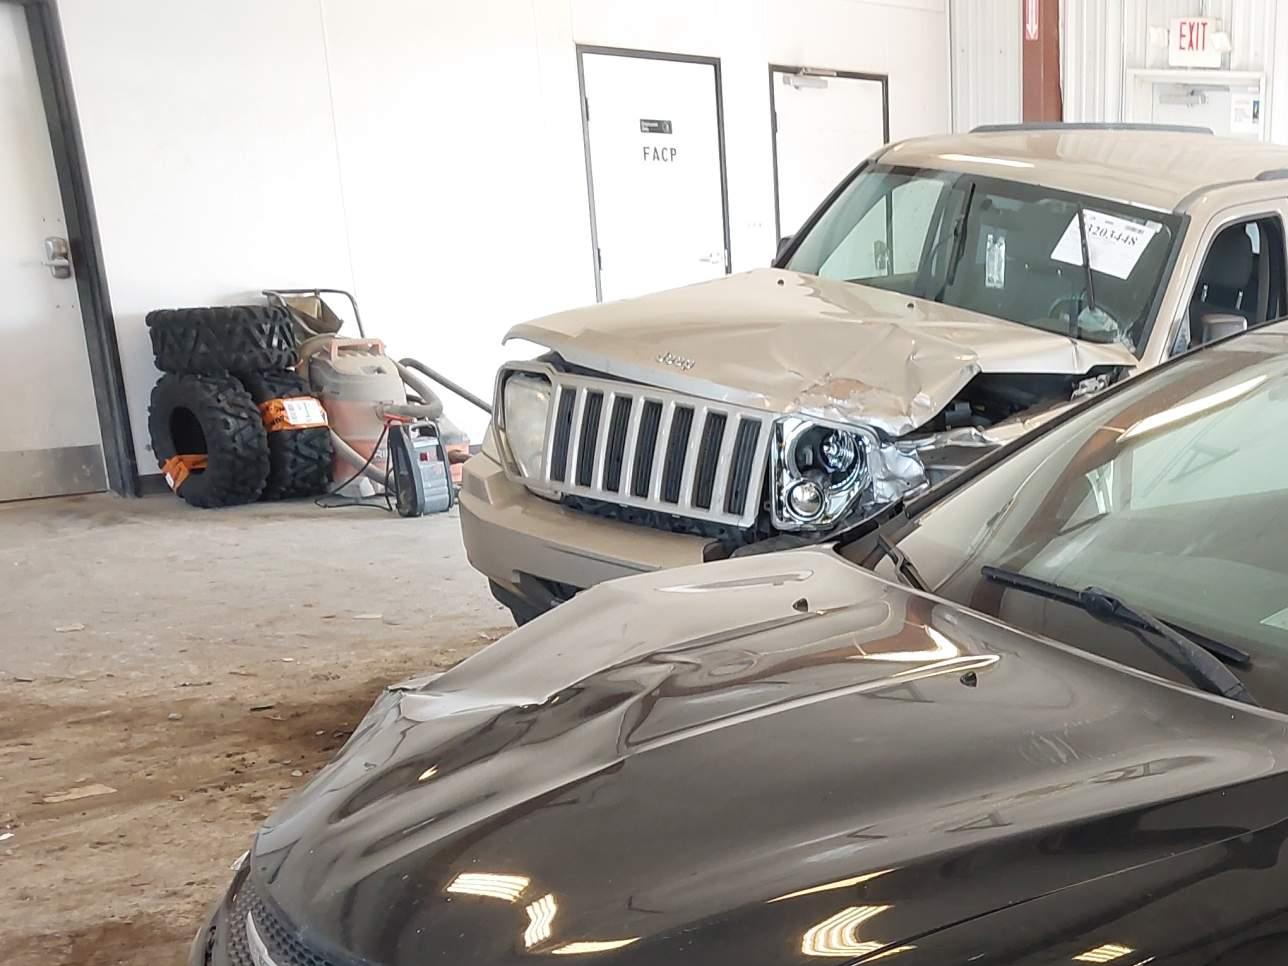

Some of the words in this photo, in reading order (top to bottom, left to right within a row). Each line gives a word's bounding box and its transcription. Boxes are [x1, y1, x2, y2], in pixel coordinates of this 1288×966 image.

[1179, 21, 1208, 51] EXIT
[643, 146, 677, 162] FACP
[1085, 222, 1139, 247] 3203448
[656, 352, 696, 371] Jeep
